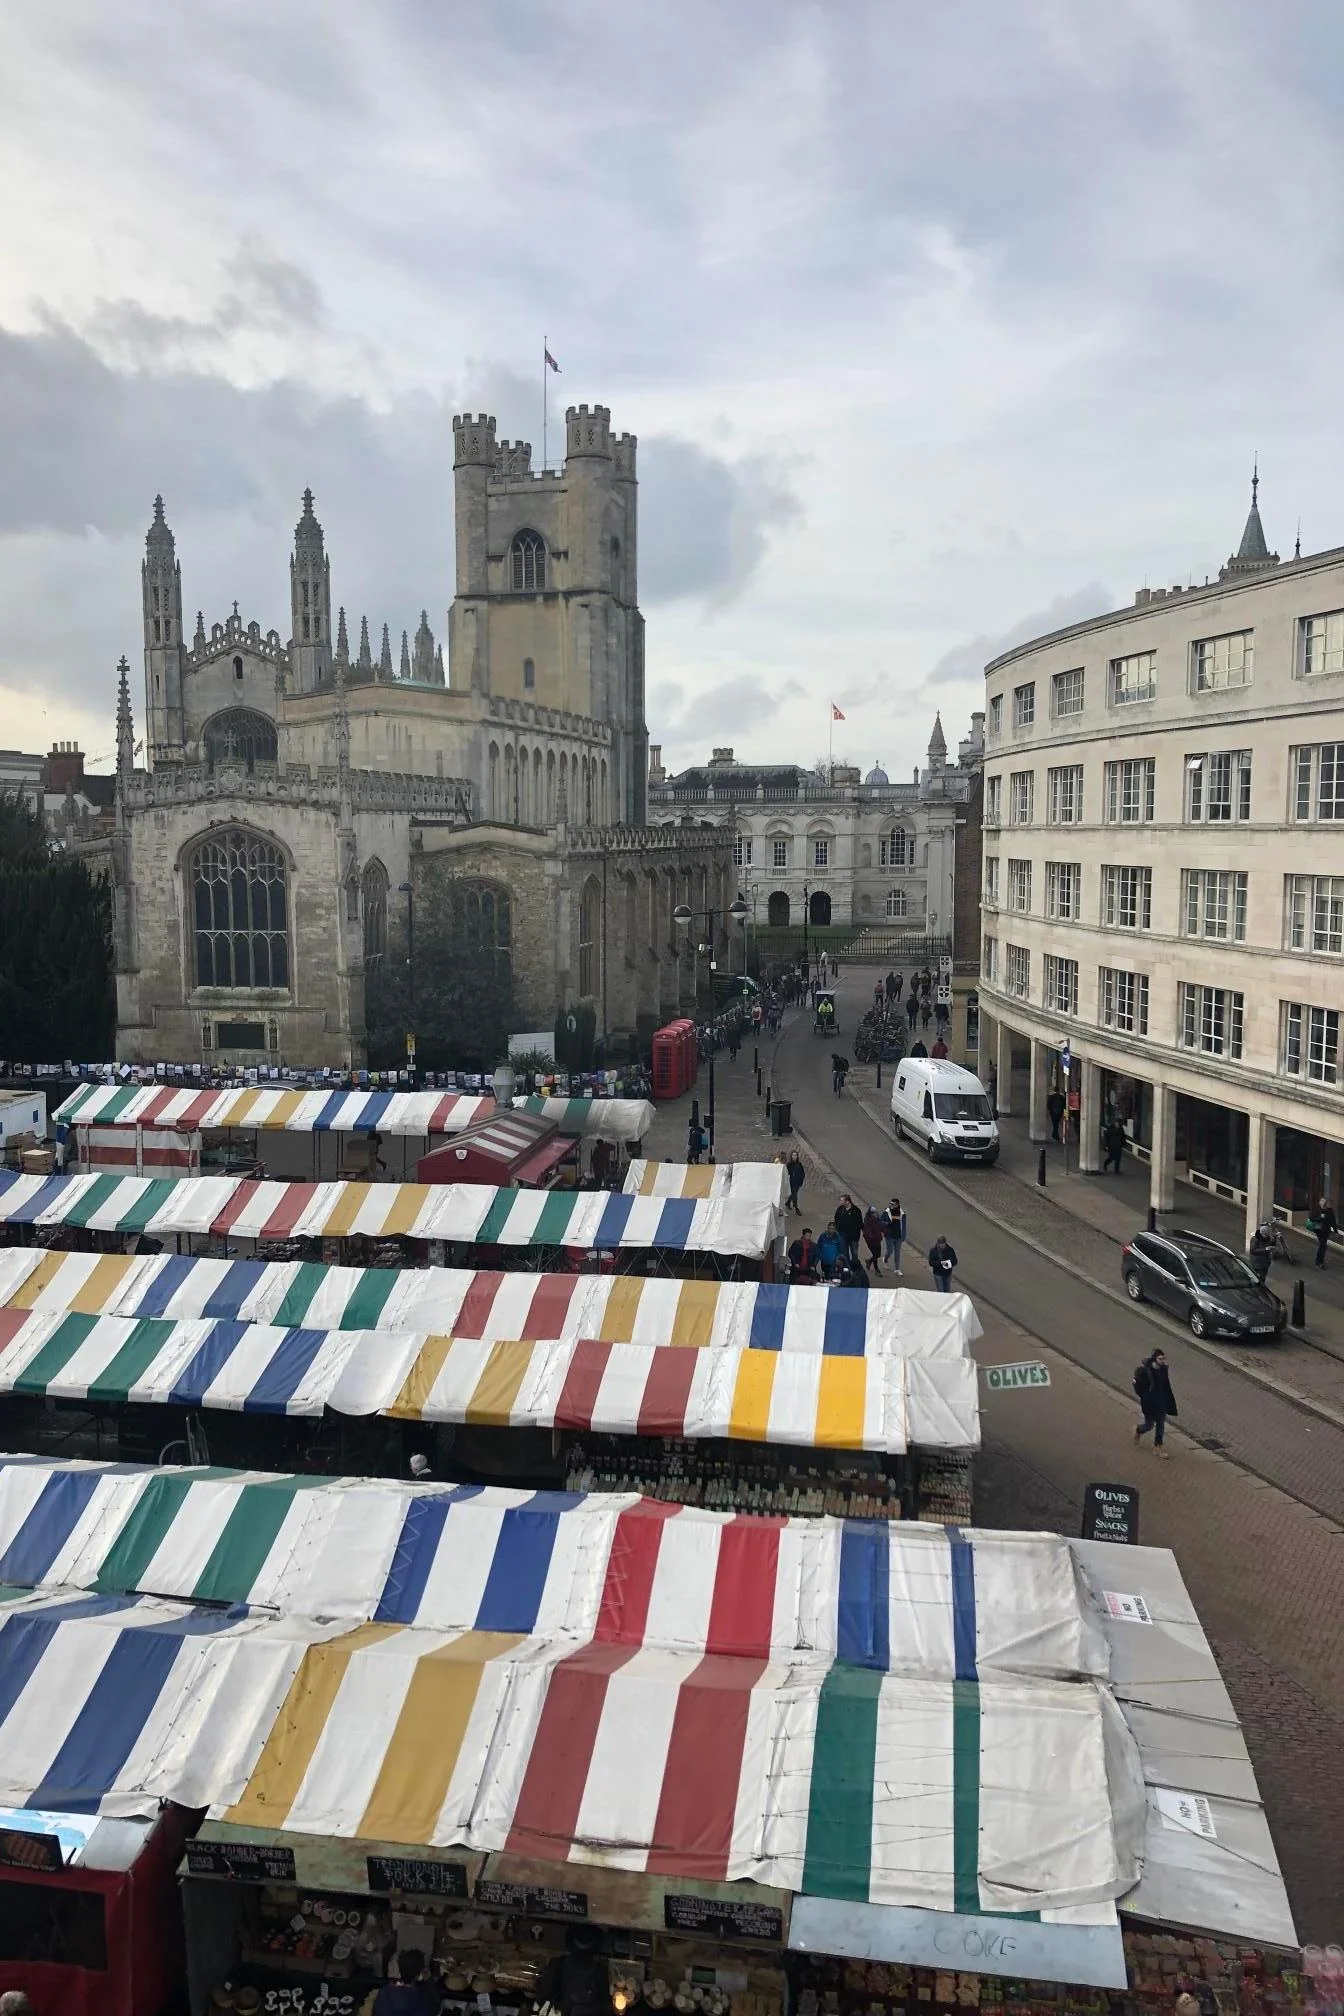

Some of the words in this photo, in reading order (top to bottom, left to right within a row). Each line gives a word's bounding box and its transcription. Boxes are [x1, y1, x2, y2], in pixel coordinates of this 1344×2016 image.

[990, 1366, 1048, 1387] OLIVES
[1095, 1489, 1130, 1503] OLIVES
[1095, 1519, 1128, 1532] SNACKS
[1180, 1806, 1192, 1819] NO
[1195, 1798, 1214, 1834] PARKING
